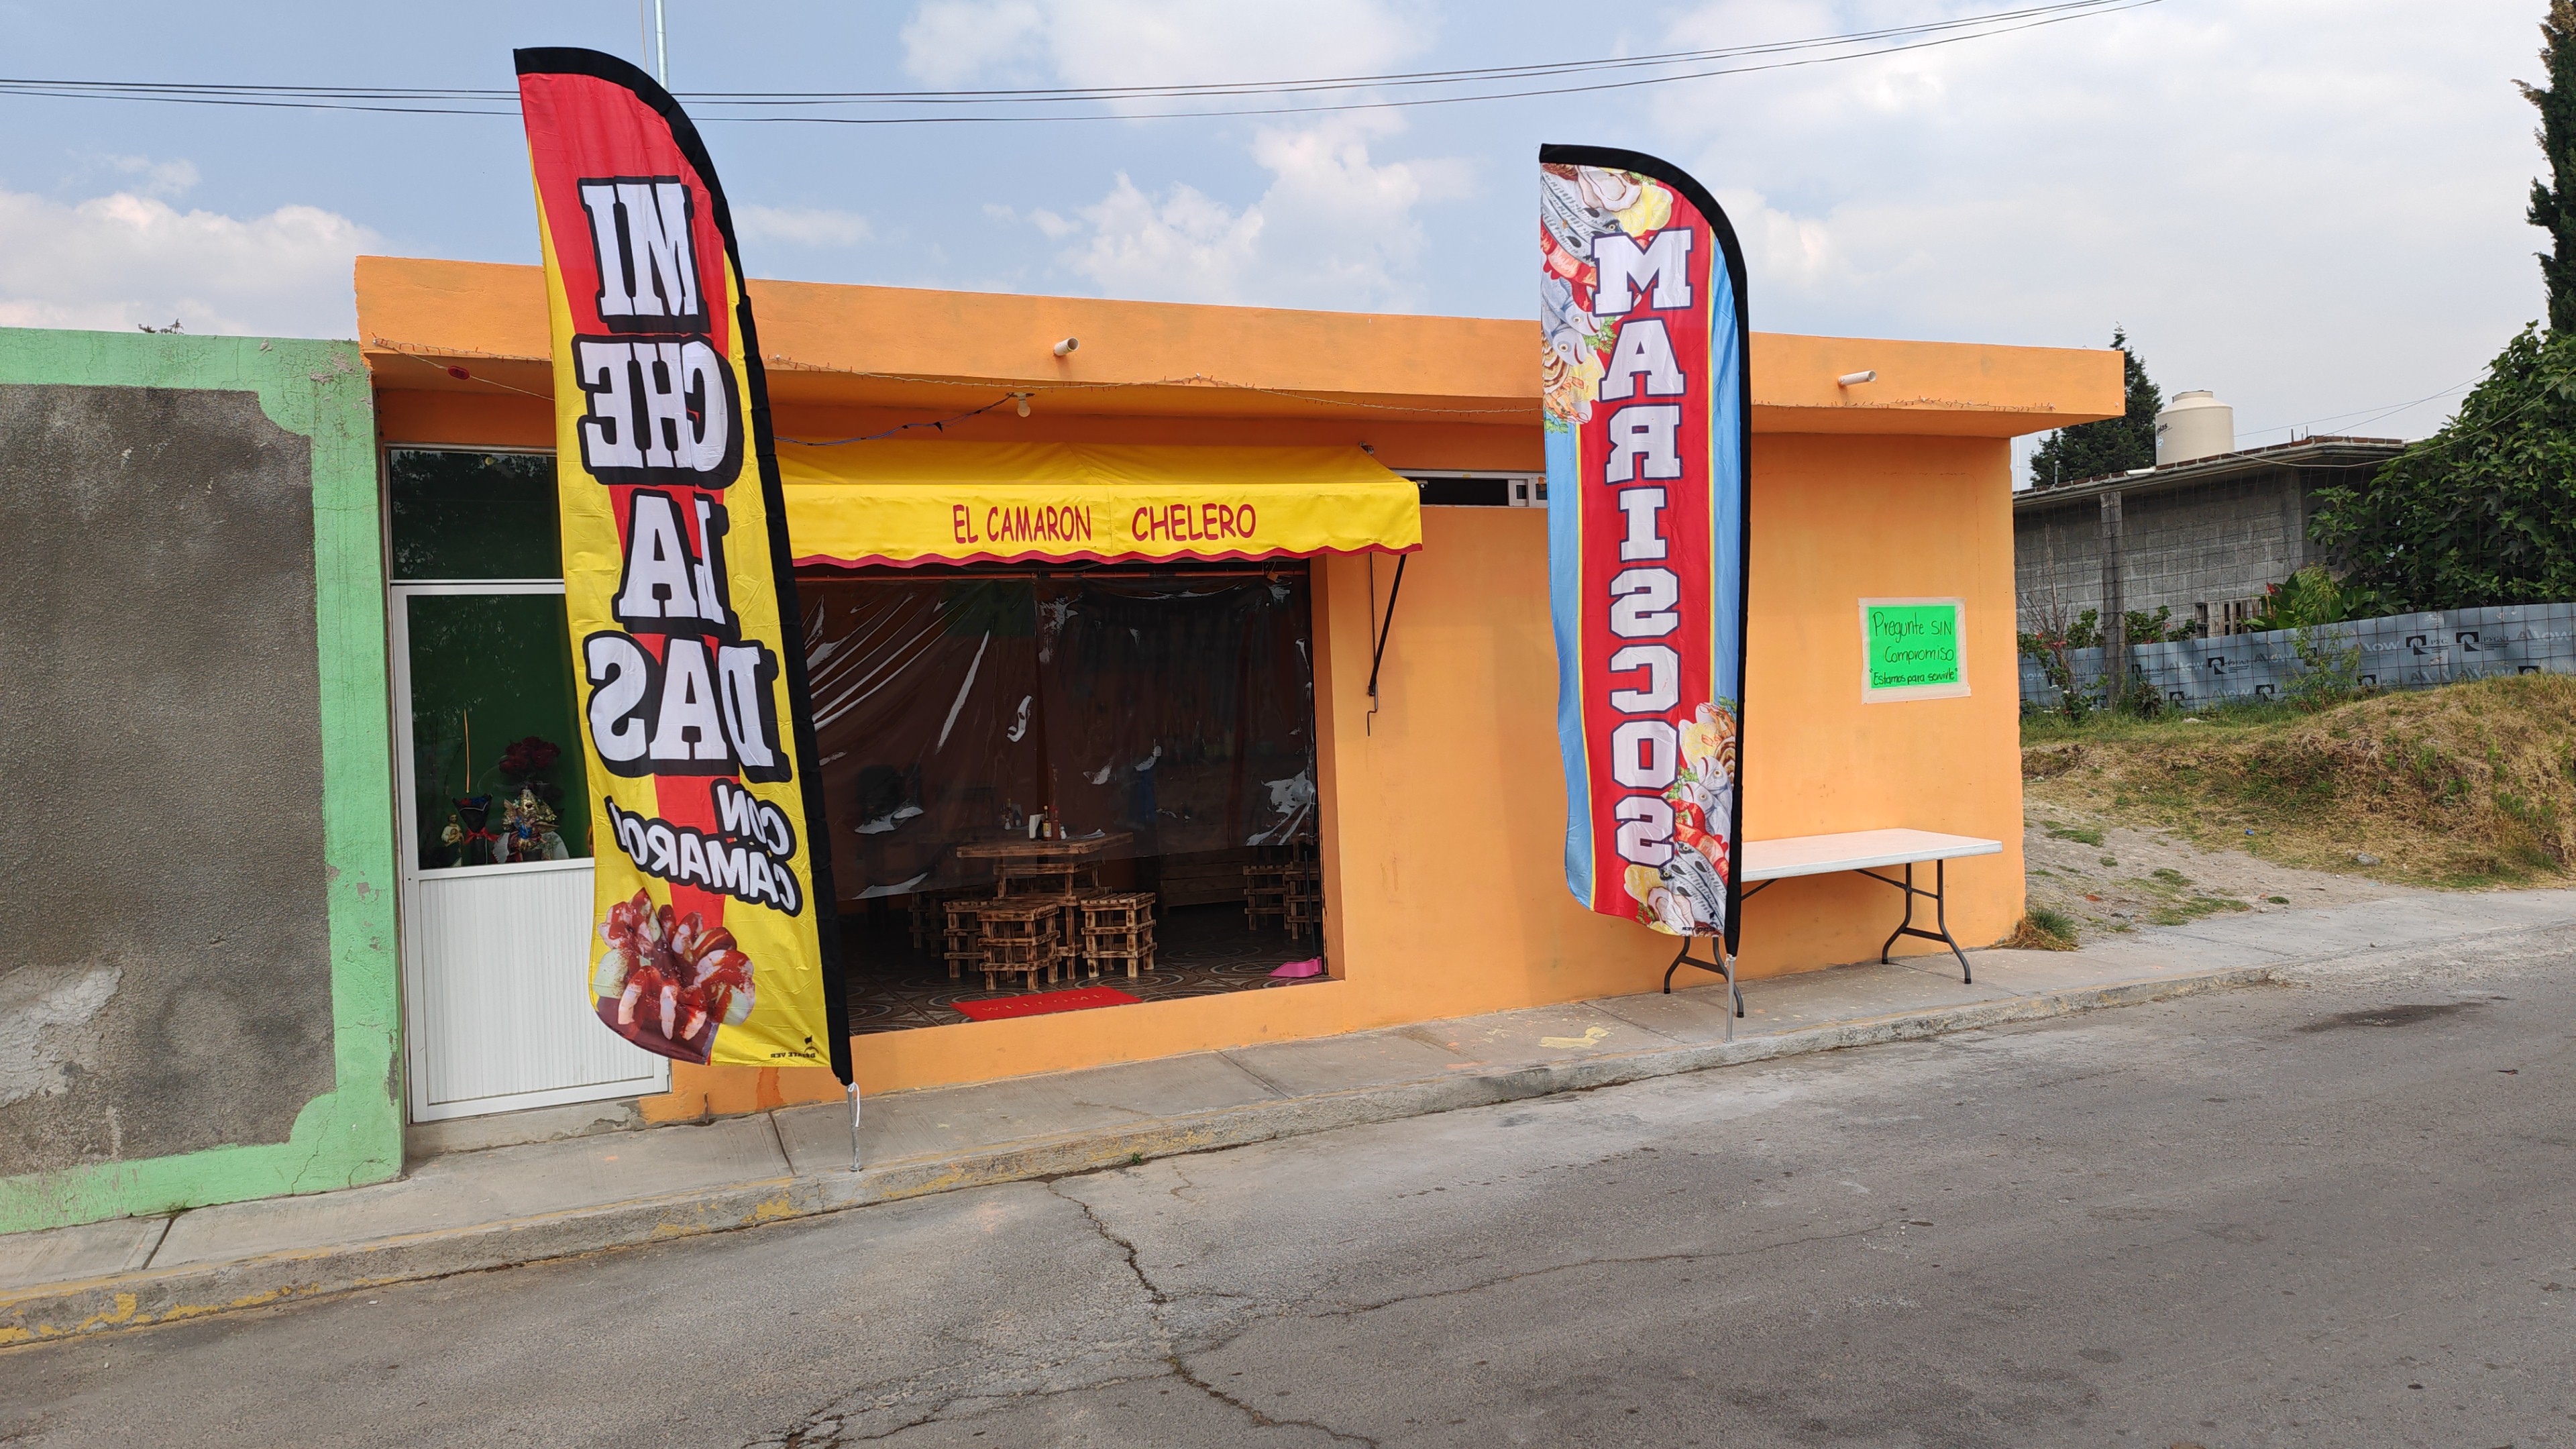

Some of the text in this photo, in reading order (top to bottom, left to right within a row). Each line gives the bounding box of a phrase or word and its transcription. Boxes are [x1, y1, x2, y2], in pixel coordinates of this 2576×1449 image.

[953, 503, 1256, 543] EL CAMARON CHELERO
[1872, 611, 1951, 643] Pregunte SIN
[1885, 645, 1953, 665] Compromiso
[1907, 674, 1925, 685] para
